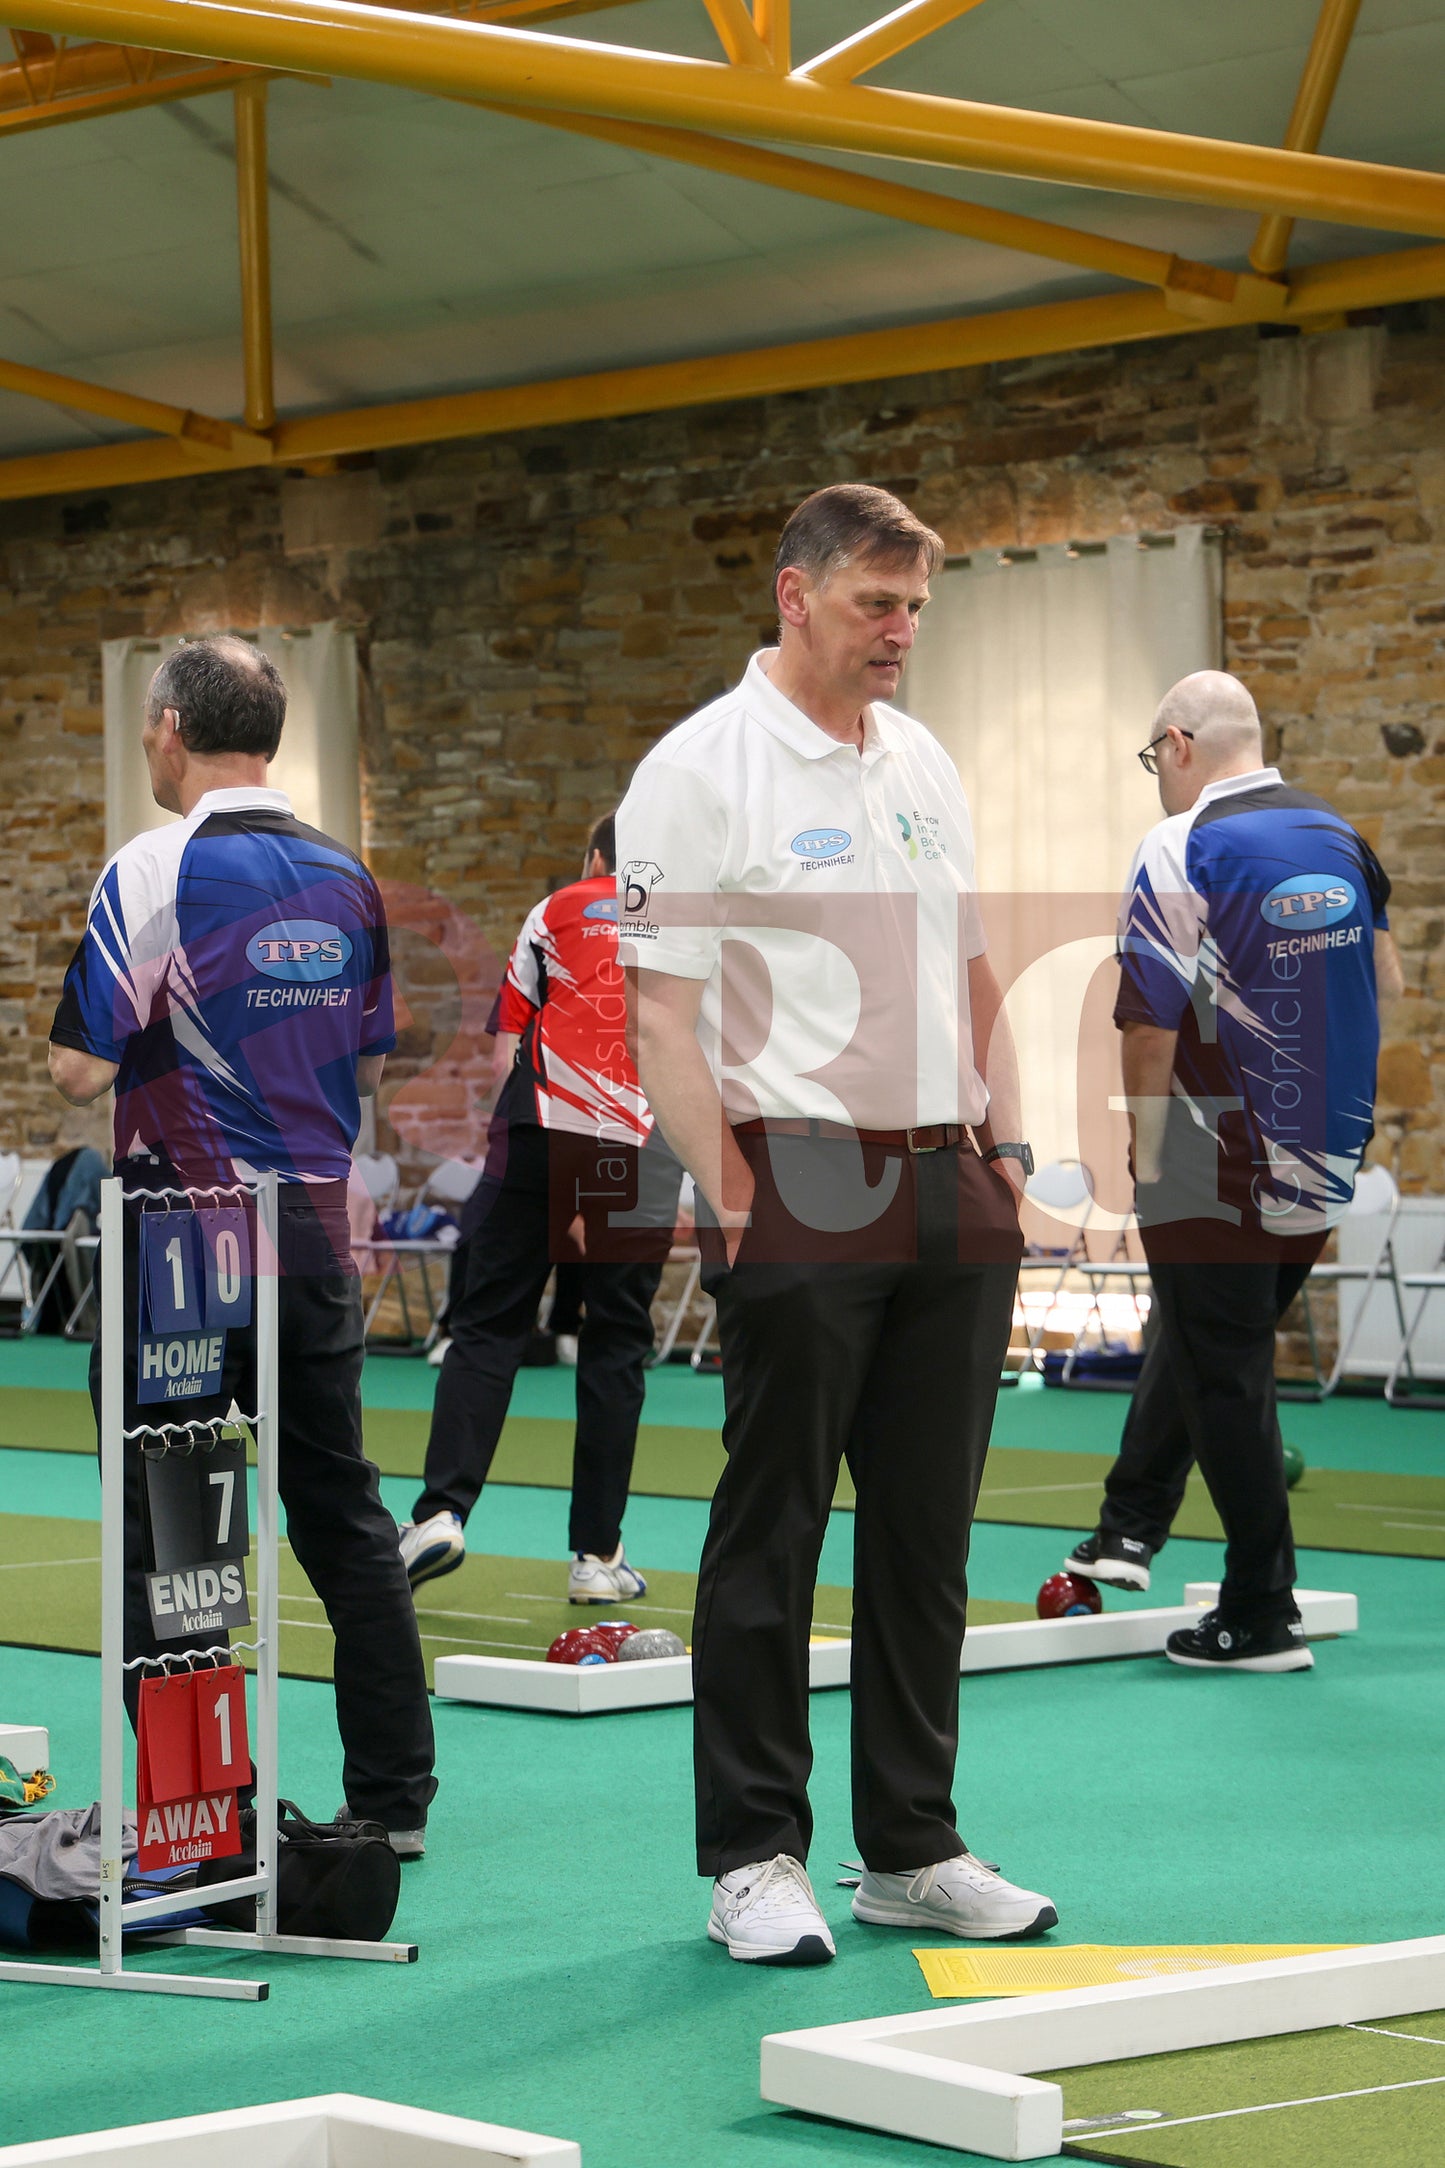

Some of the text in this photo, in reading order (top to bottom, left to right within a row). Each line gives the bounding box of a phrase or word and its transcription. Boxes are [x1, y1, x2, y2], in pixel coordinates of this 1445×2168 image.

[797, 834, 845, 851] TPS
[800, 854, 855, 871] TECHNIHEAT
[1270, 887, 1349, 917] TPS
[258, 939, 343, 962] TPS
[1266, 926, 1363, 959] TECHNIHEAT
[246, 988, 352, 1008] TECHNIHEAT
[143, 1336, 223, 1379] HOME
[164, 1376, 202, 1398] Acclaim
[208, 1470, 235, 1545] 7
[150, 1564, 243, 1616] ENDS
[181, 1609, 223, 1633] Acclaim
[214, 1693, 233, 1766] 1
[143, 1795, 232, 1847] AWAY
[168, 1839, 213, 1864] Acclaim
